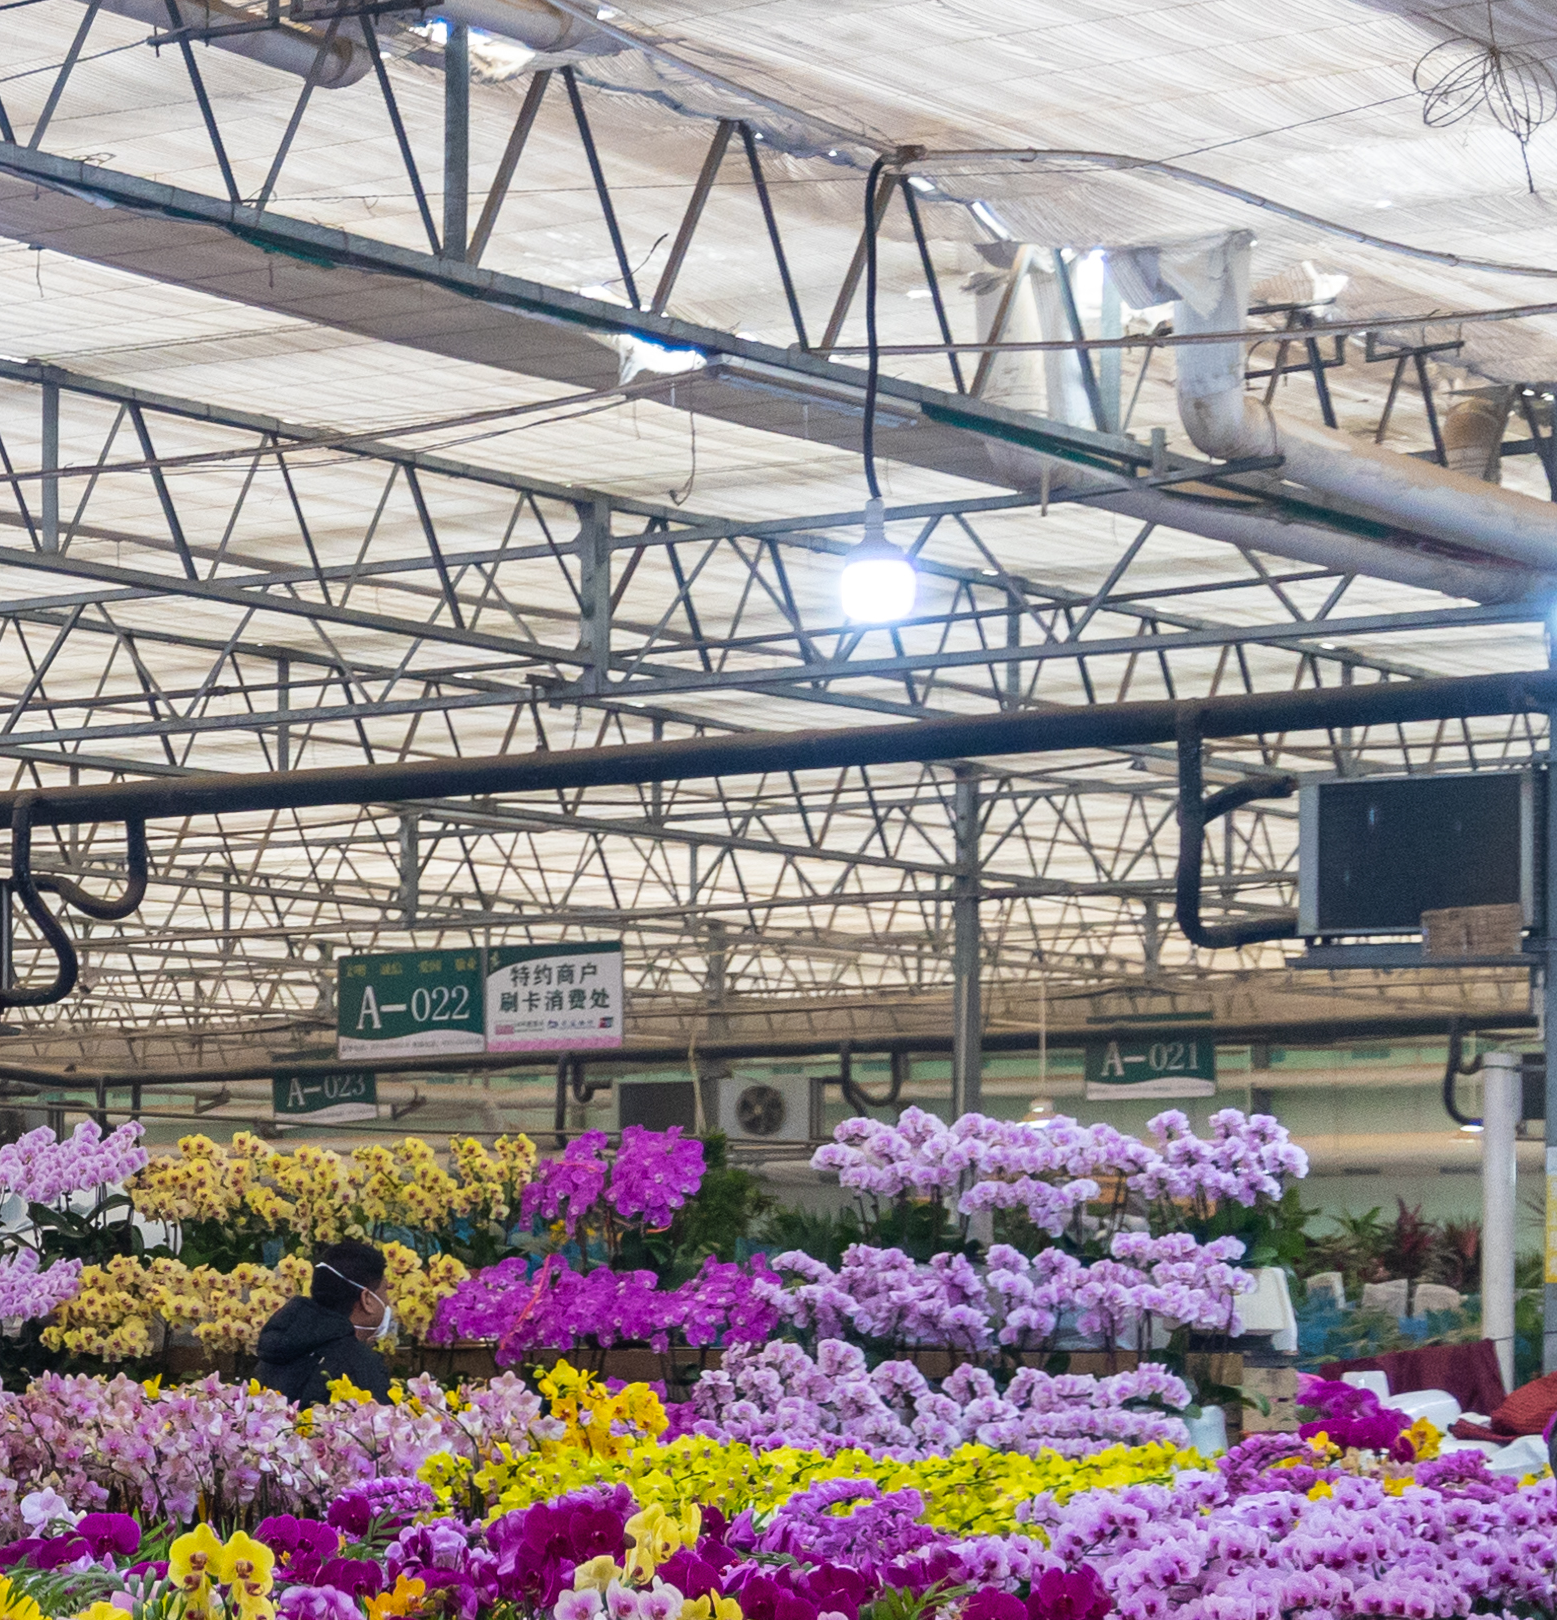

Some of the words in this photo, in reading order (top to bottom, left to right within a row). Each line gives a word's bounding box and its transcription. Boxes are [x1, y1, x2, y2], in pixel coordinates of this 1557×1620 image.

[510, 962, 597, 987] 特约商户
[356, 985, 470, 1030] A-022
[499, 988, 610, 1013] 刷卡消费处
[1100, 1041, 1200, 1077] A-021
[286, 1073, 366, 1108] A-023
